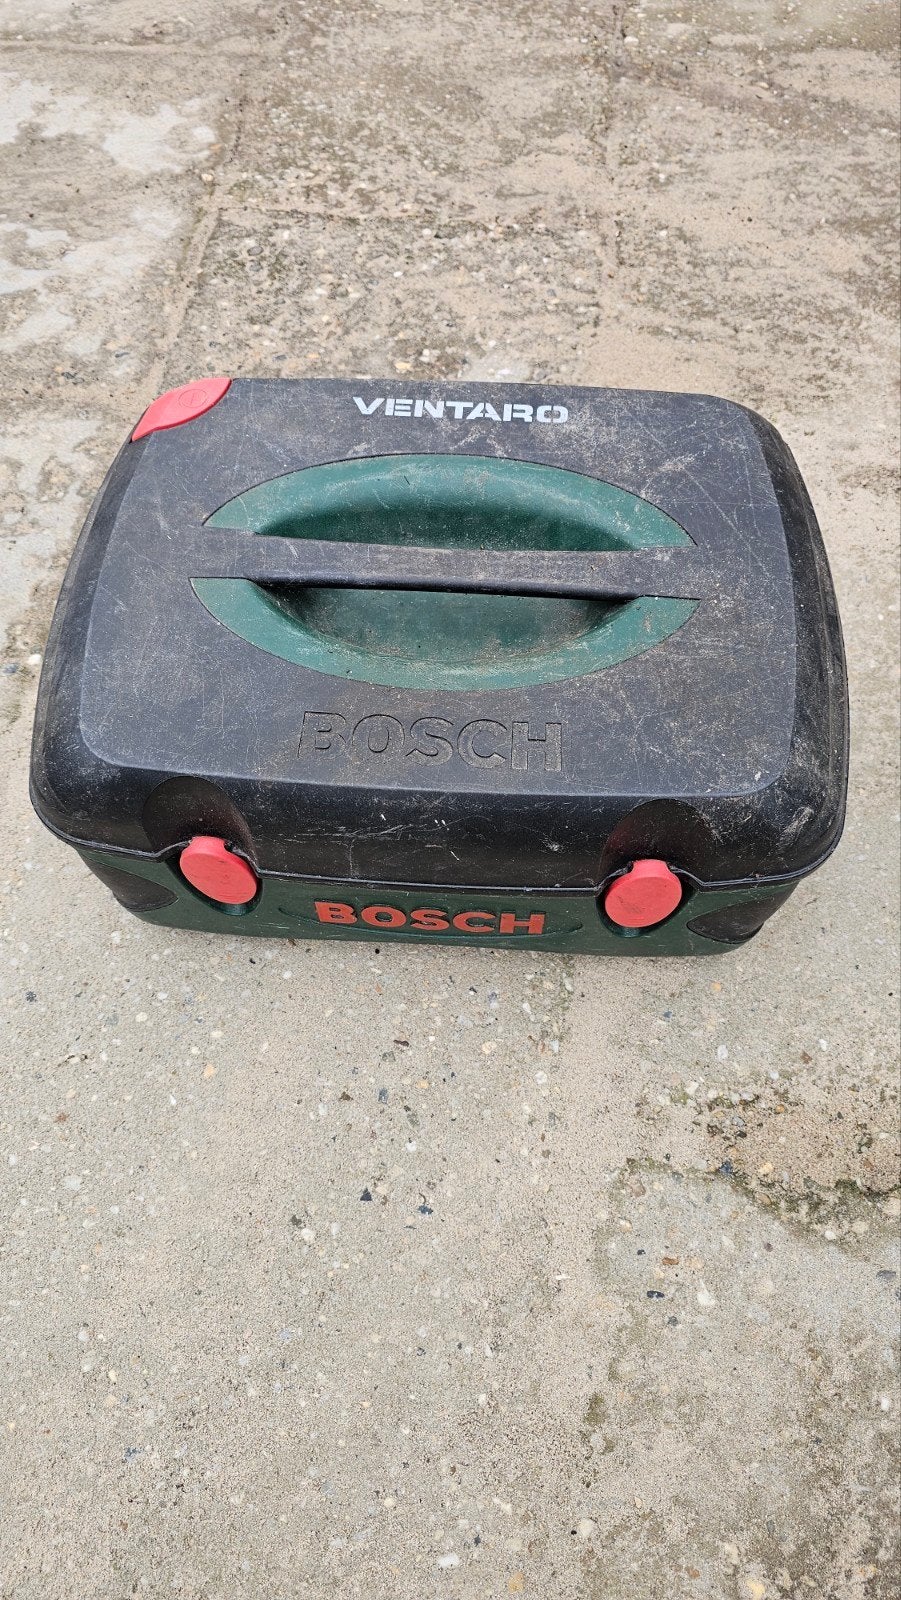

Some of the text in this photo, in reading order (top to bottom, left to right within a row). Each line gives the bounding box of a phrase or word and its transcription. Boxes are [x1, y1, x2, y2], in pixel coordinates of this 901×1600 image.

[353, 396, 568, 424] VENTARO
[297, 710, 563, 772] BOSCH
[314, 901, 545, 935] BOSCH
